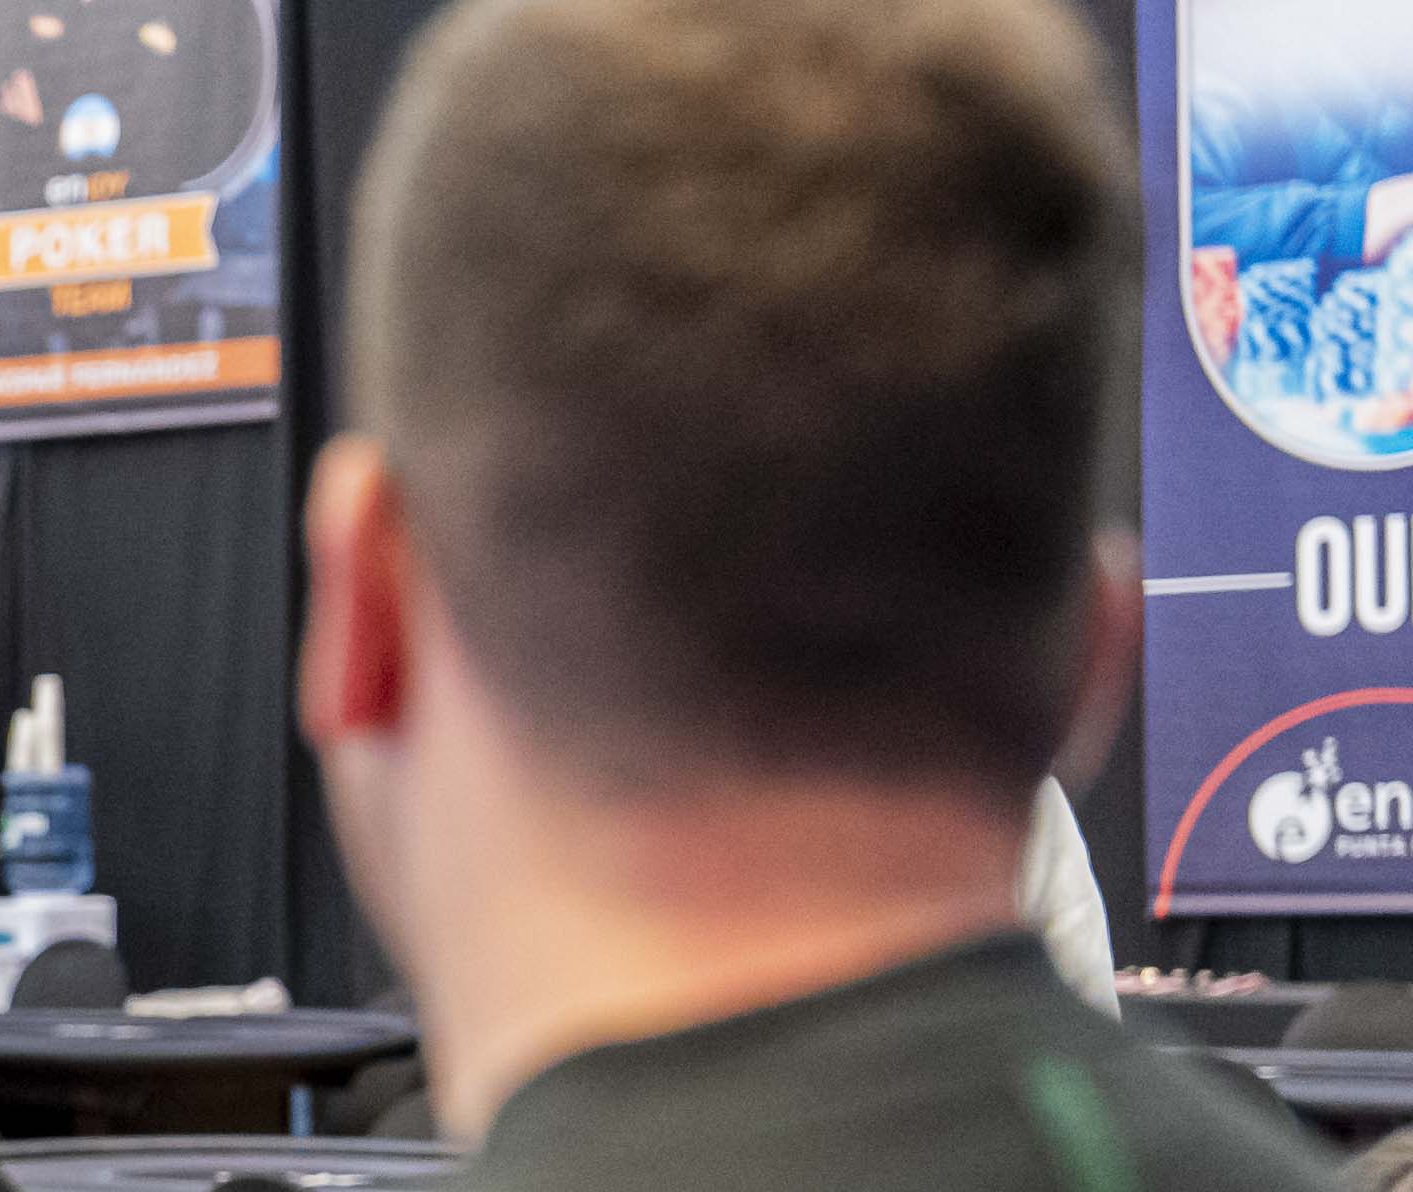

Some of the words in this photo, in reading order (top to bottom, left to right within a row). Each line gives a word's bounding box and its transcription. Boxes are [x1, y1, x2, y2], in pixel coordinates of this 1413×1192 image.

[9, 212, 170, 271] POKER
[1295, 512, 1413, 636] OU
[1335, 780, 1413, 832] en
